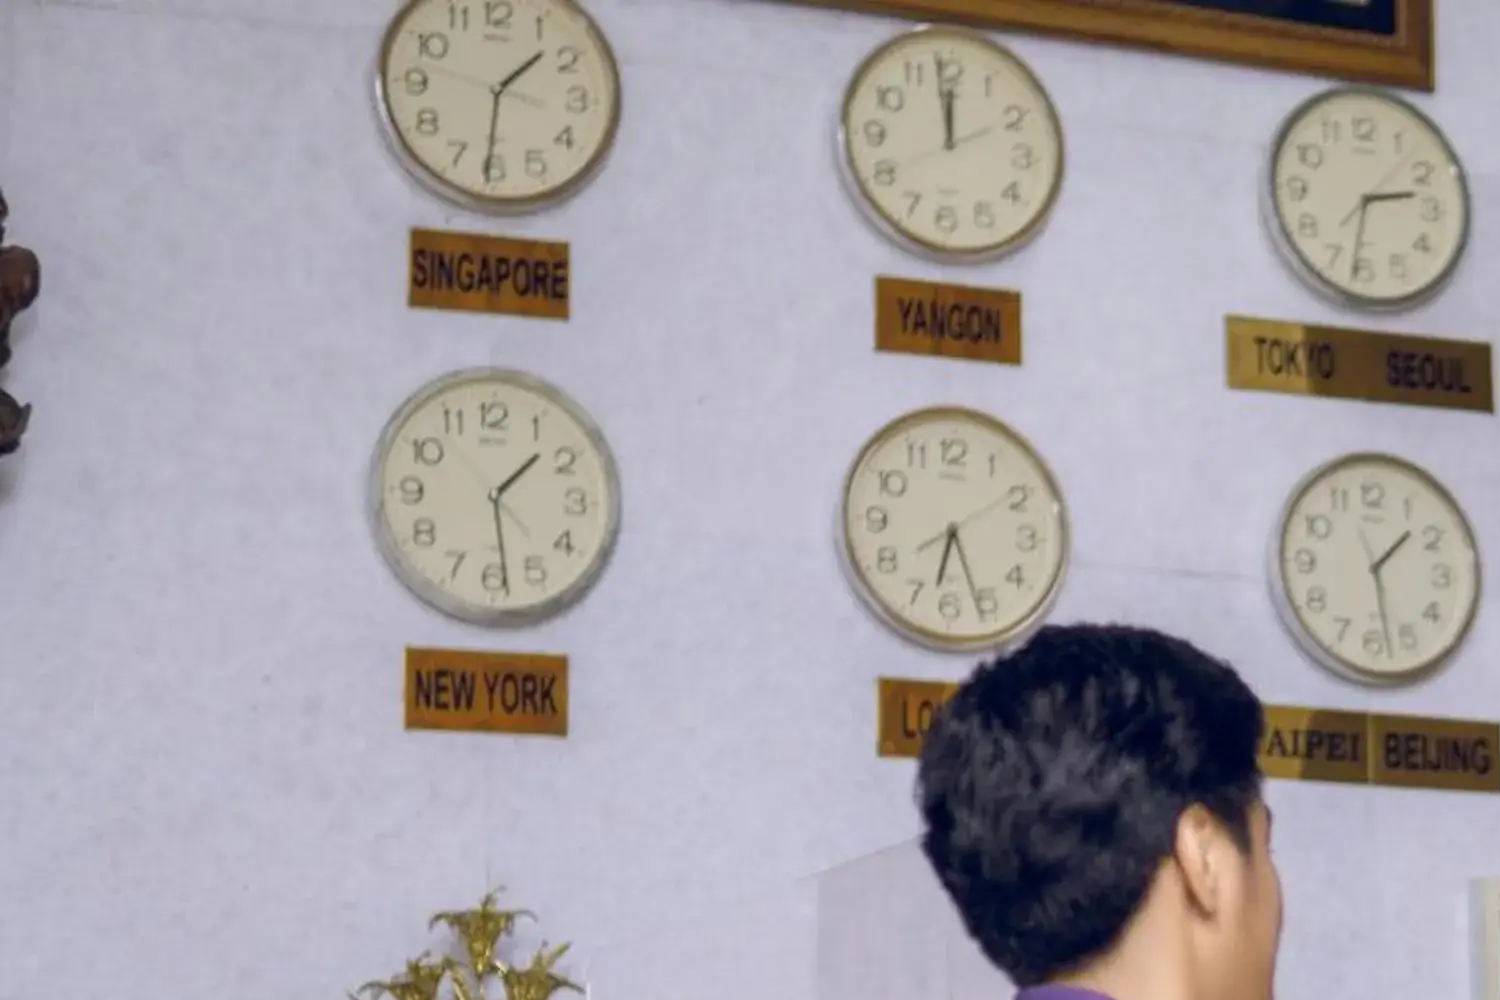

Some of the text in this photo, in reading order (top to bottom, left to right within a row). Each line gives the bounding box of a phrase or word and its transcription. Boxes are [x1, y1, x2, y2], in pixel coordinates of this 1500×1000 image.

[450, 4, 469, 31] 11
[485, 2, 513, 27] 12
[536, 16, 543, 41] 1
[418, 33, 449, 59] 10
[557, 46, 578, 74] 2
[405, 67, 428, 95] 9
[565, 86, 588, 113] 3
[416, 109, 439, 135] 8
[553, 125, 575, 149] 4
[448, 140, 468, 168] 7
[525, 150, 546, 177] 5
[413, 250, 568, 298] SINGAPORE
[897, 297, 1000, 343] YANGON
[1253, 337, 1472, 393] TOKYO SEOUL
[444, 409, 463, 435] 11
[479, 401, 509, 430] 12
[532, 416, 540, 442] 1
[413, 437, 444, 465] 10
[555, 446, 576, 475] 2
[907, 445, 926, 469] 11
[940, 438, 968, 465] 12
[989, 453, 995, 479] 1
[400, 476, 424, 505] 9
[879, 469, 908, 497] 10
[1361, 482, 1385, 508] 12
[565, 487, 587, 515] 3
[1007, 485, 1028, 512] 2
[1331, 487, 1348, 512] 11
[1404, 497, 1411, 521] 1
[413, 518, 435, 546] 8
[866, 505, 887, 533] 9
[1305, 514, 1333, 540] 10
[553, 529, 575, 556] 4
[1016, 525, 1037, 552] 3
[1422, 525, 1442, 550] 2
[445, 551, 465, 581] 7
[524, 555, 547, 585] 5
[877, 547, 897, 573] 8
[1295, 548, 1317, 574] 9
[482, 563, 506, 592] 6
[1005, 564, 1024, 590] 4
[1431, 564, 1450, 589] 3
[906, 578, 924, 606] 7
[1306, 586, 1327, 613] 8
[938, 593, 960, 620] 6
[1422, 602, 1440, 624] 4
[1333, 617, 1352, 643] 7
[1362, 629, 1383, 655] 6
[1399, 623, 1418, 650] 5
[415, 669, 557, 715] NEW YORK
[1265, 728, 1490, 775] AIPEI BEIJING
